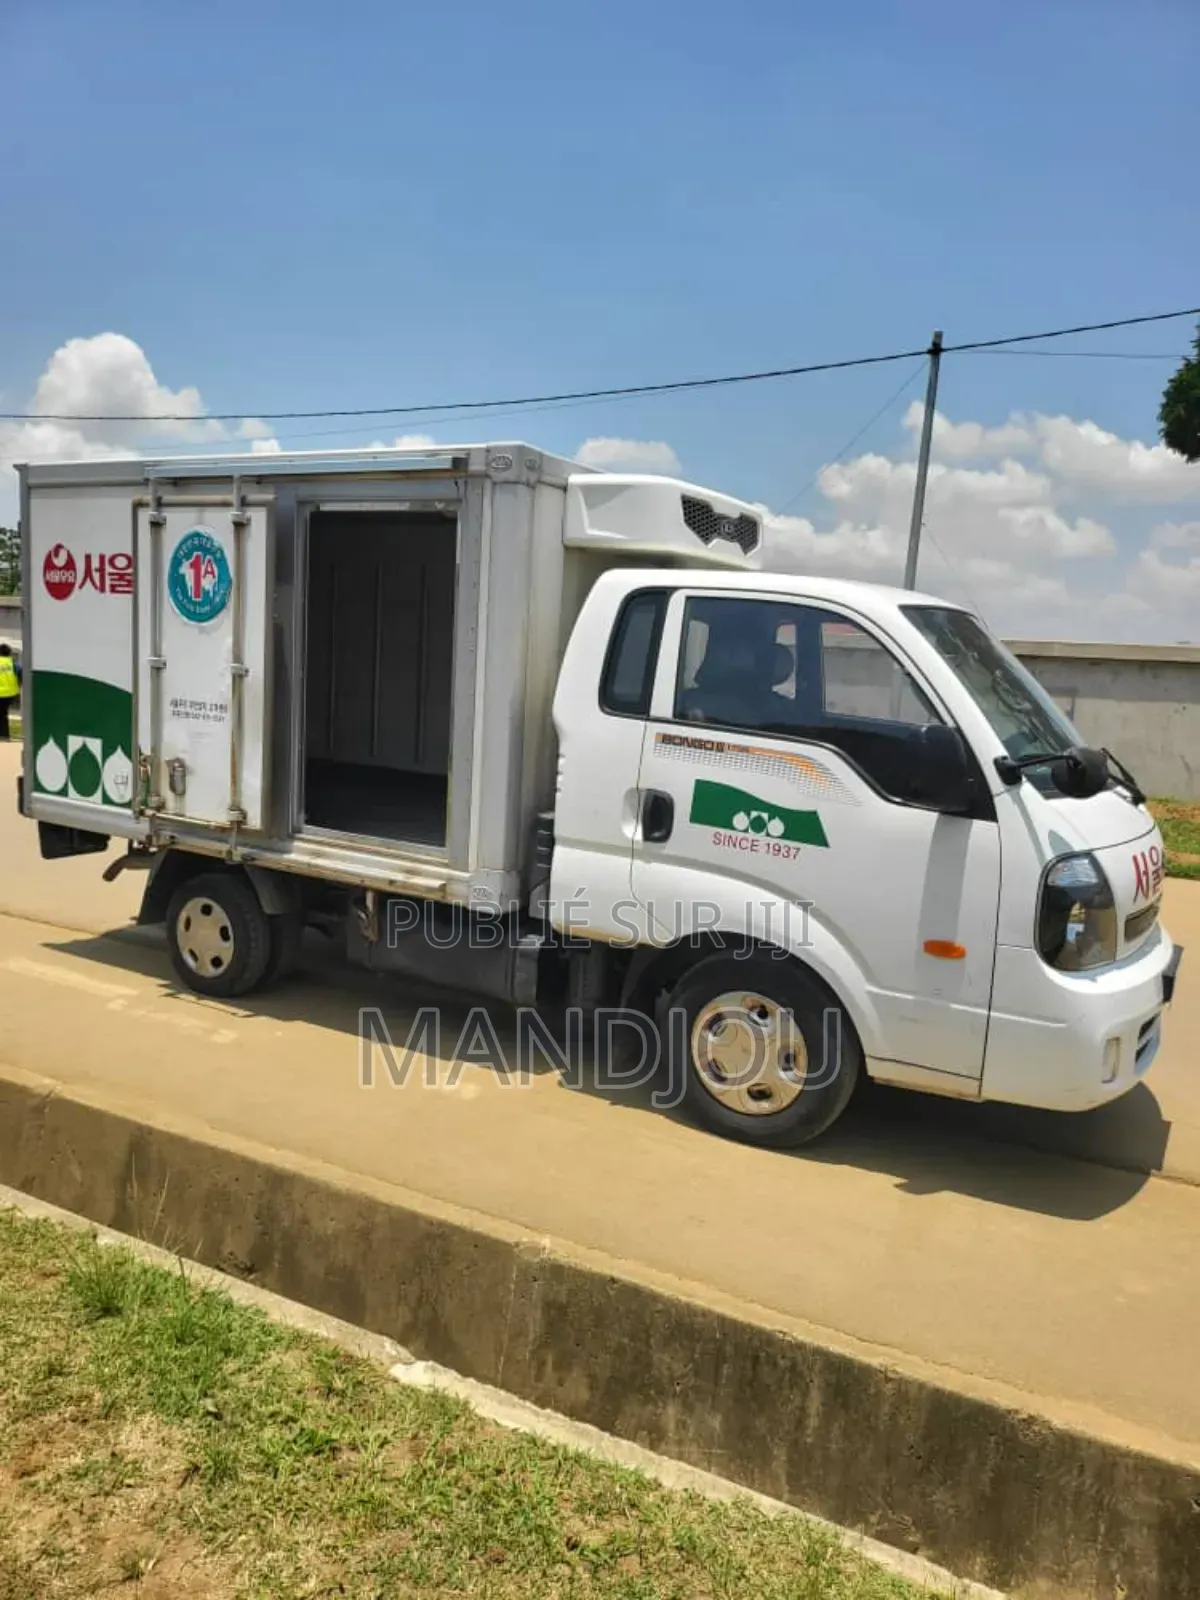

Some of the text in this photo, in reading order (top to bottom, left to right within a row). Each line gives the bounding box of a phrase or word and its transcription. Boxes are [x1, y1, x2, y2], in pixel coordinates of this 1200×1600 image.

[78, 553, 134, 594] 서울
[662, 733, 715, 752] BONGO
[712, 831, 801, 860] SINCE 1937
